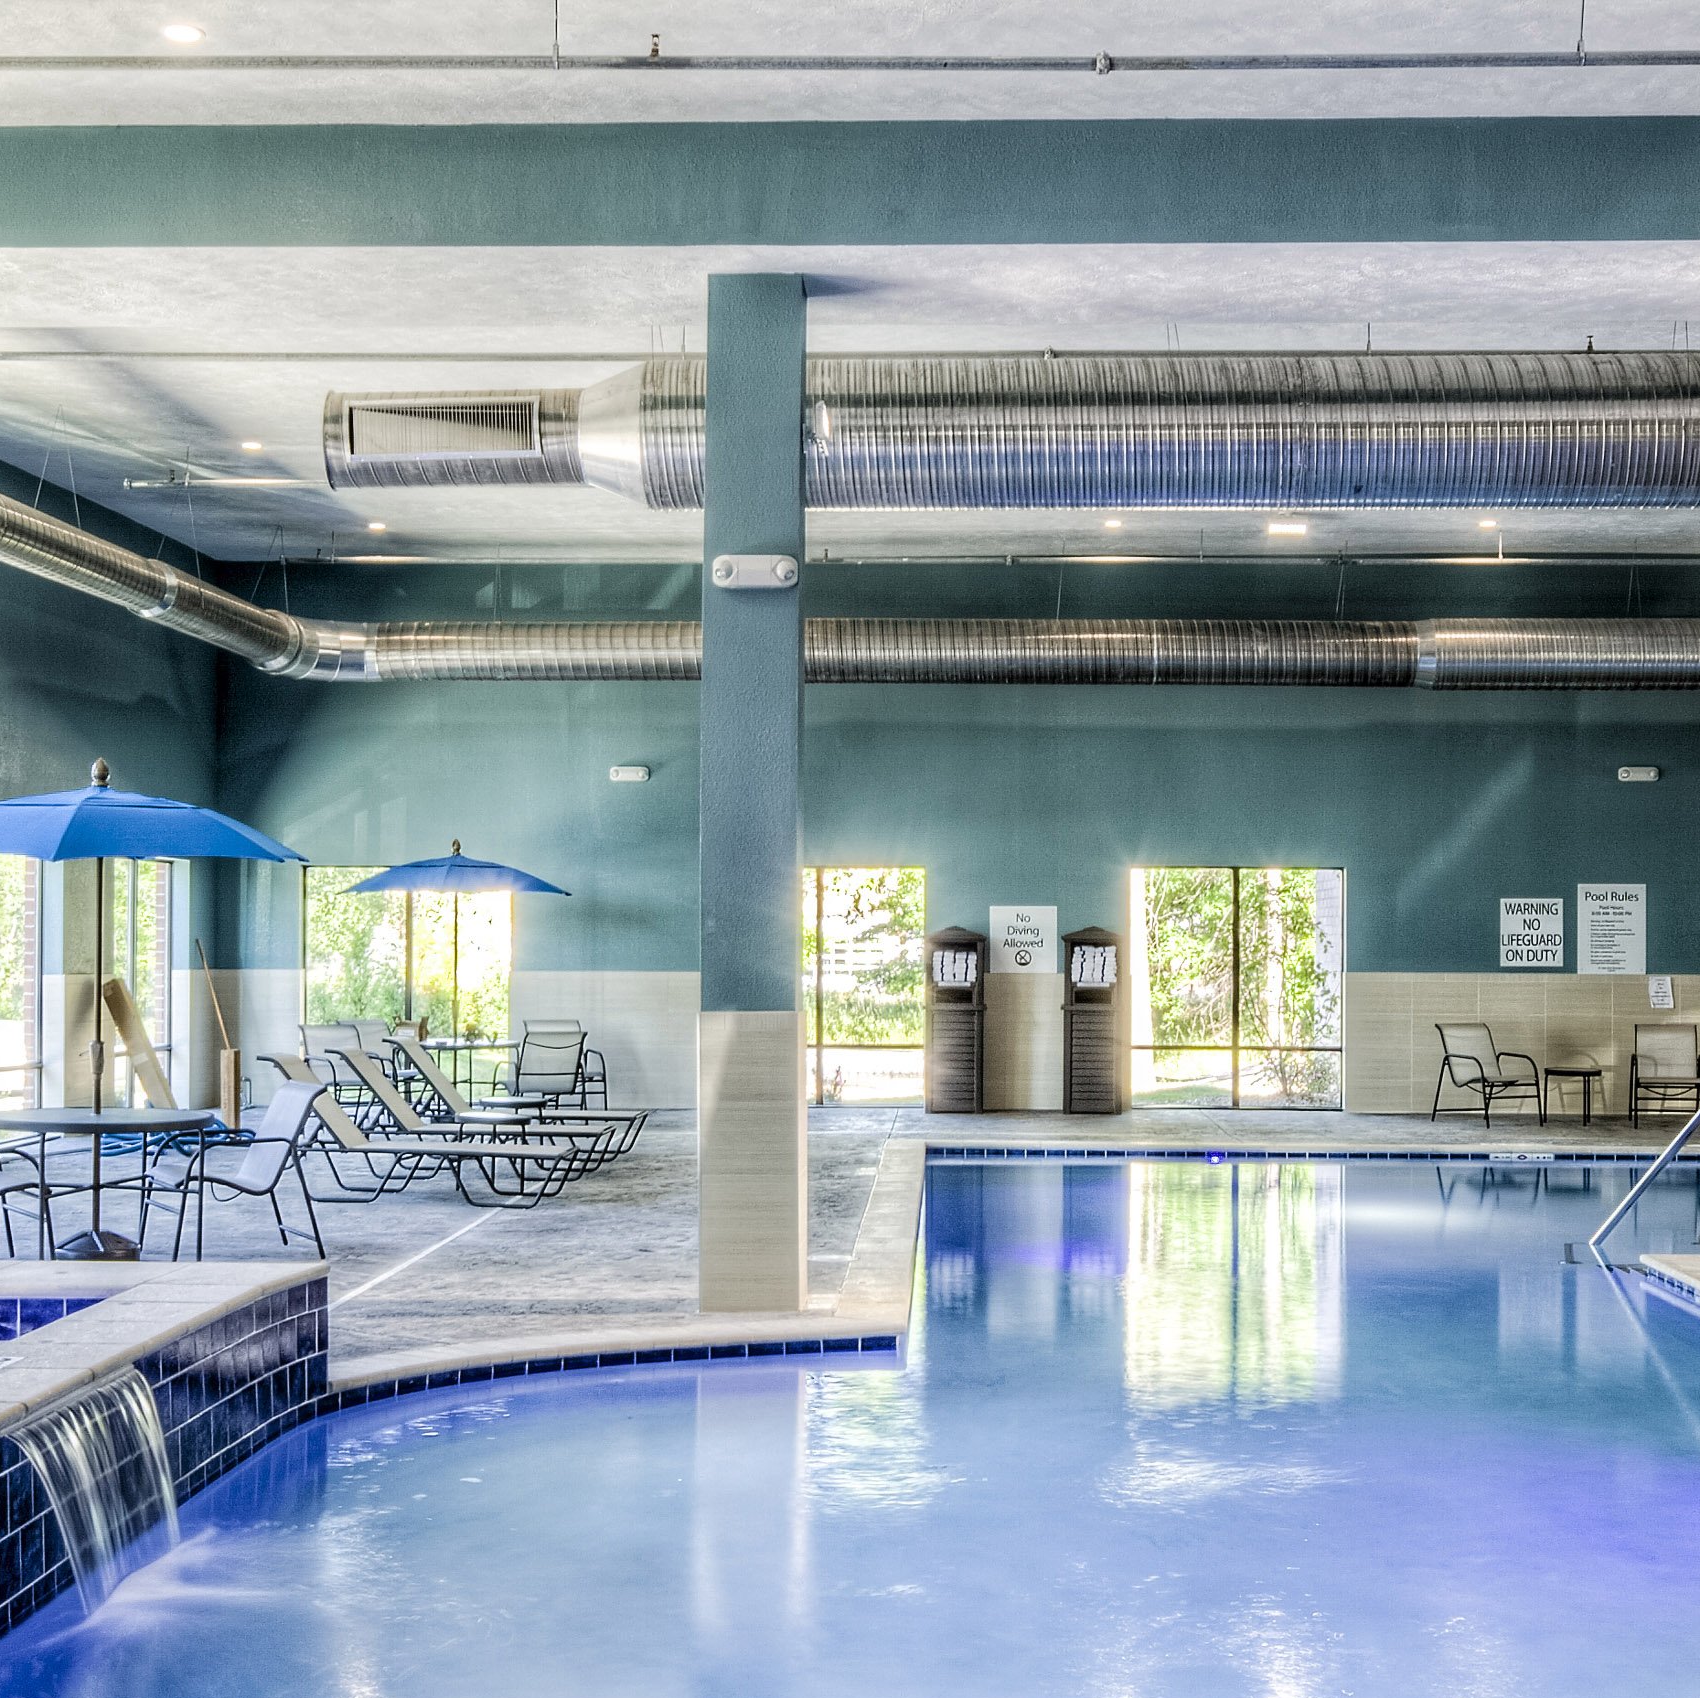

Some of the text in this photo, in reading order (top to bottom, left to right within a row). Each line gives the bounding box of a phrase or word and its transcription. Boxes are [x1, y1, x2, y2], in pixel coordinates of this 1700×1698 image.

[1585, 892, 1639, 902] Pool Rules
[1505, 902, 1559, 916] WARNING
[1016, 912, 1031, 923] No
[1522, 918, 1541, 932] NO
[1007, 926, 1040, 938] Diving
[1002, 938, 1044, 949] Allowed
[1502, 934, 1562, 947] LIFEGUARD
[1506, 949, 1558, 962] ON DUTY
